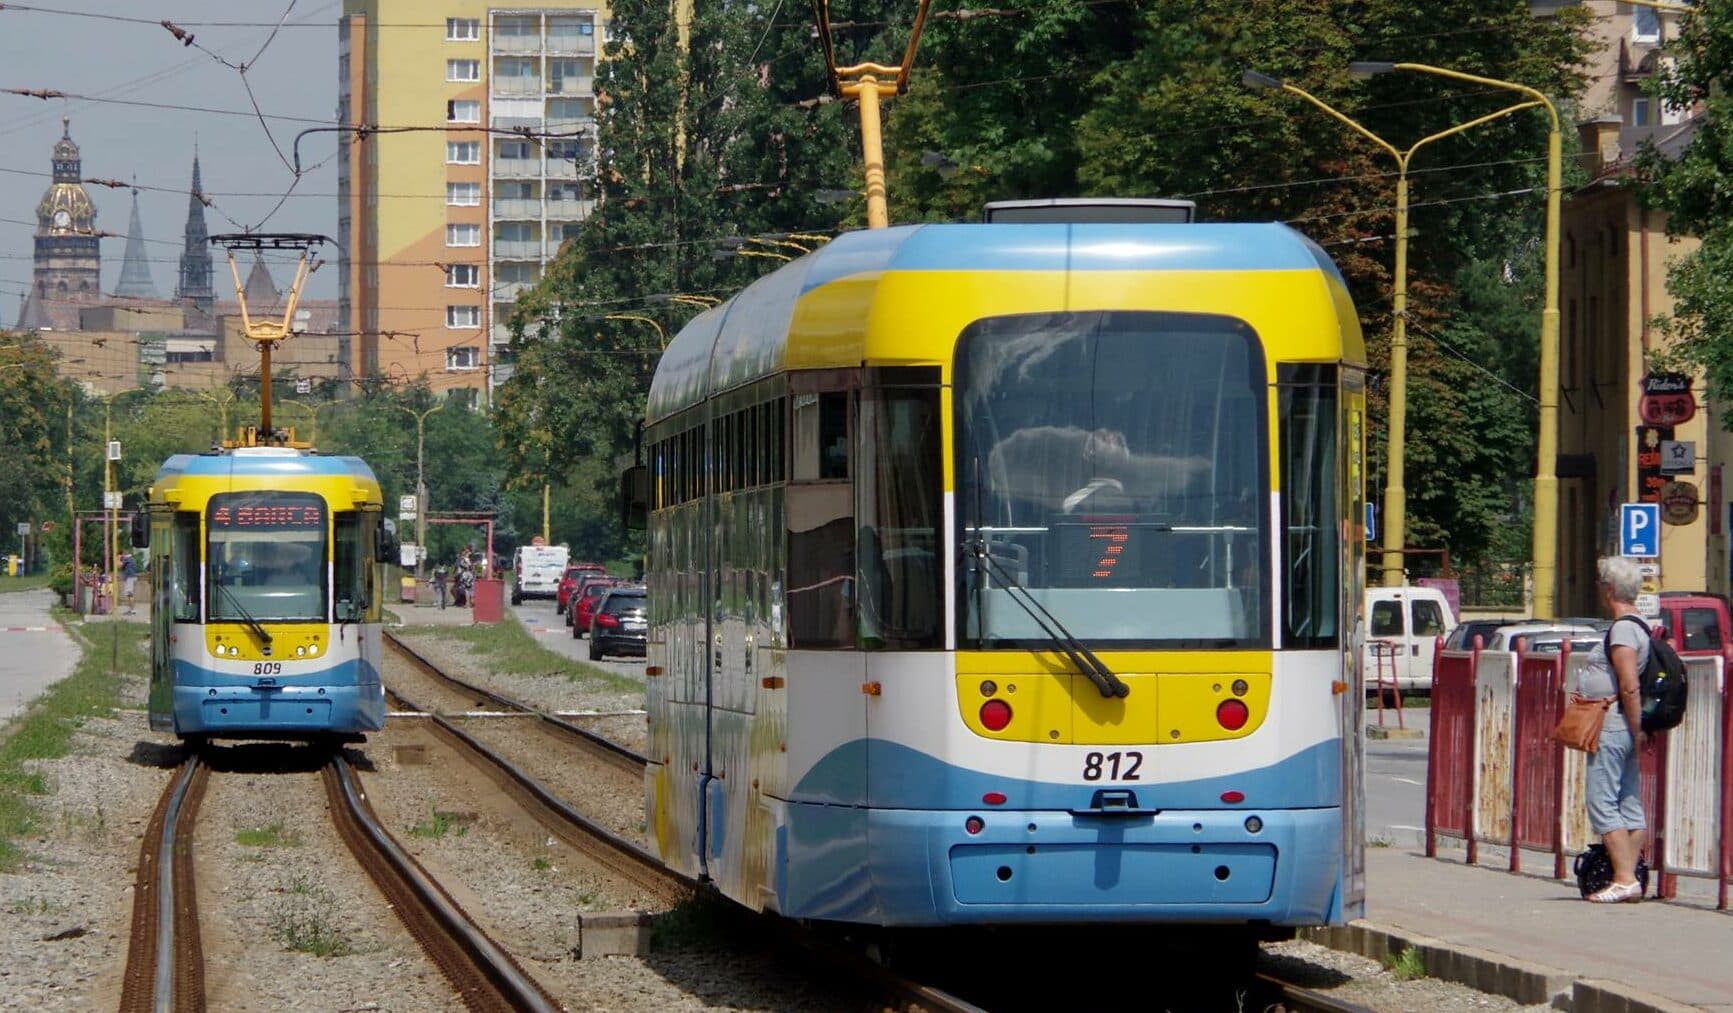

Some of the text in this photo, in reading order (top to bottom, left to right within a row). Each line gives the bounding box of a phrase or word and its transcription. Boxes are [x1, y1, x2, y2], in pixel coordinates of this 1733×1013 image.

[214, 506, 320, 526] 4 BARCA
[1630, 509, 1649, 540] P
[1090, 525, 1128, 577] 7
[254, 662, 282, 675] 809
[1083, 751, 1143, 781] 812
